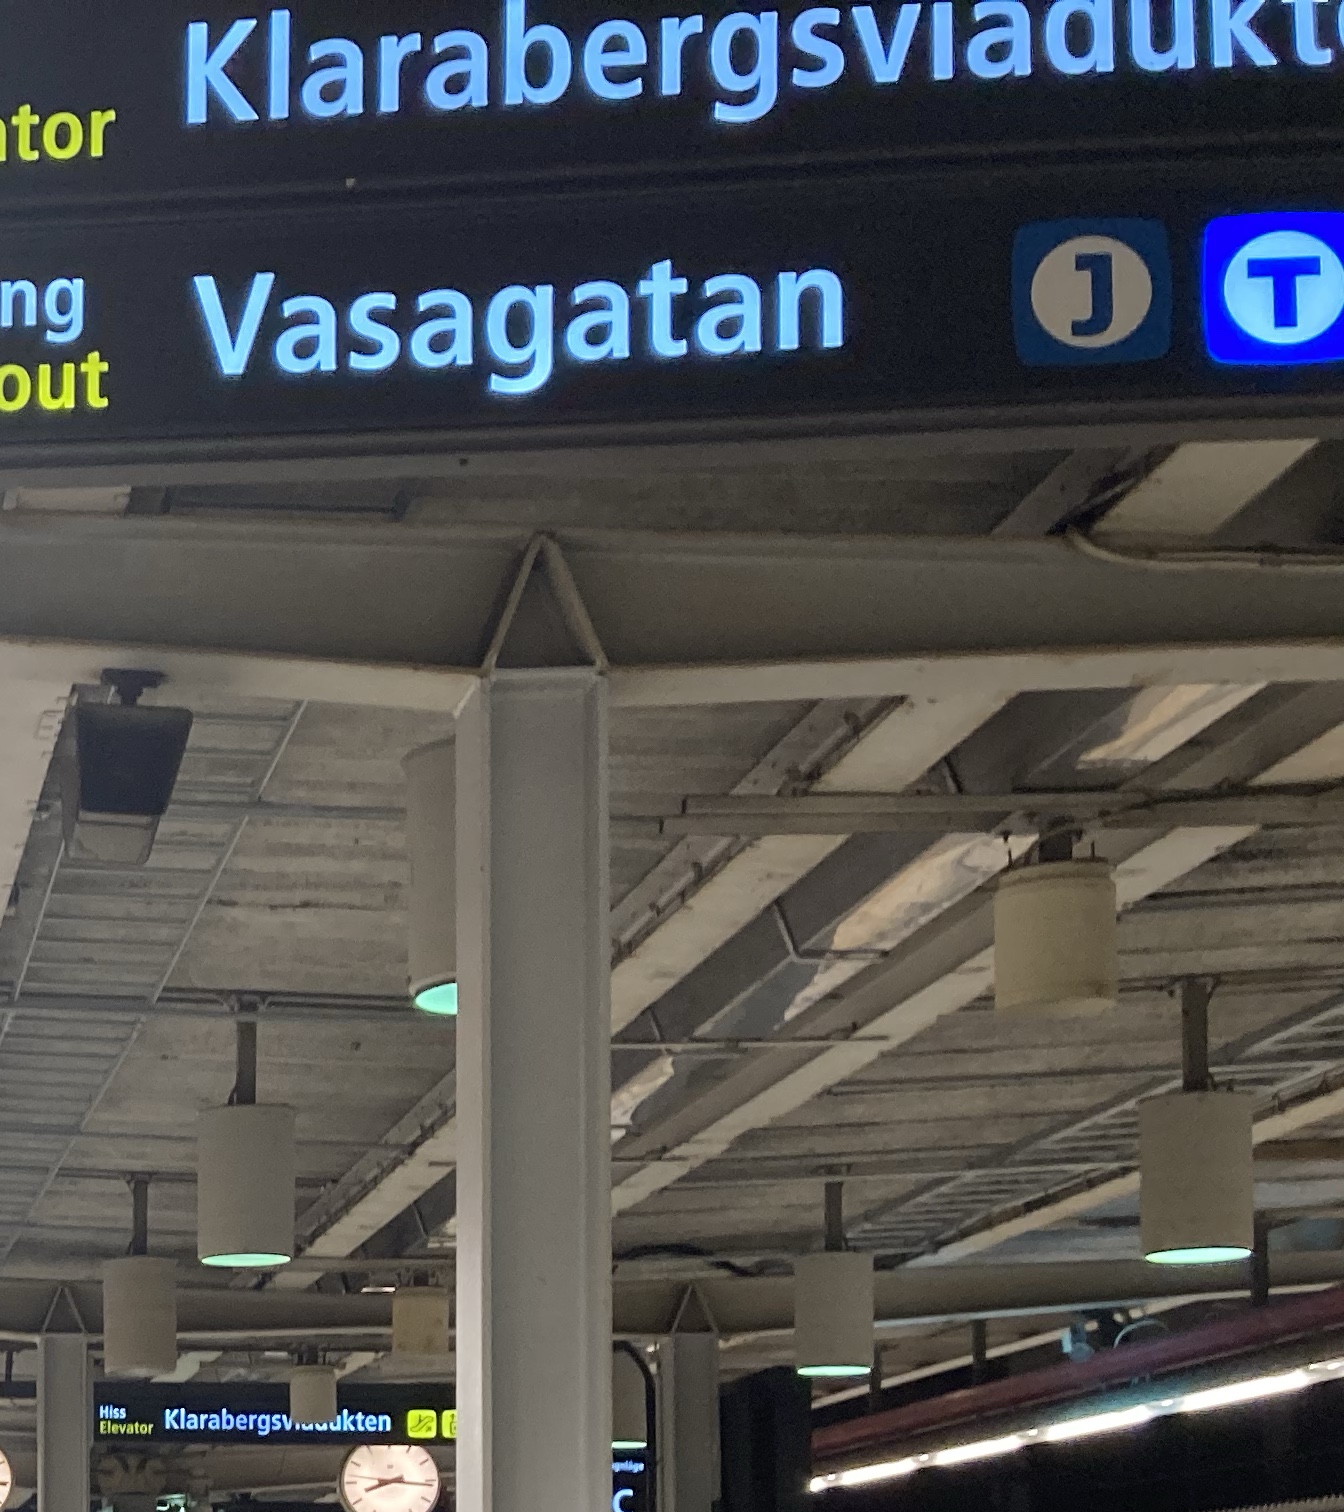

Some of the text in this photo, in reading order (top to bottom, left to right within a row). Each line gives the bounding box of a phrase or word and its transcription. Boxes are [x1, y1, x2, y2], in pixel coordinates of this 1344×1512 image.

[184, 0, 1344, 125] Klarabergsviadukt
[193, 258, 846, 393] Vasagatan
[99, 1404, 127, 1420] Hiss
[99, 1420, 155, 1436] Elevator
